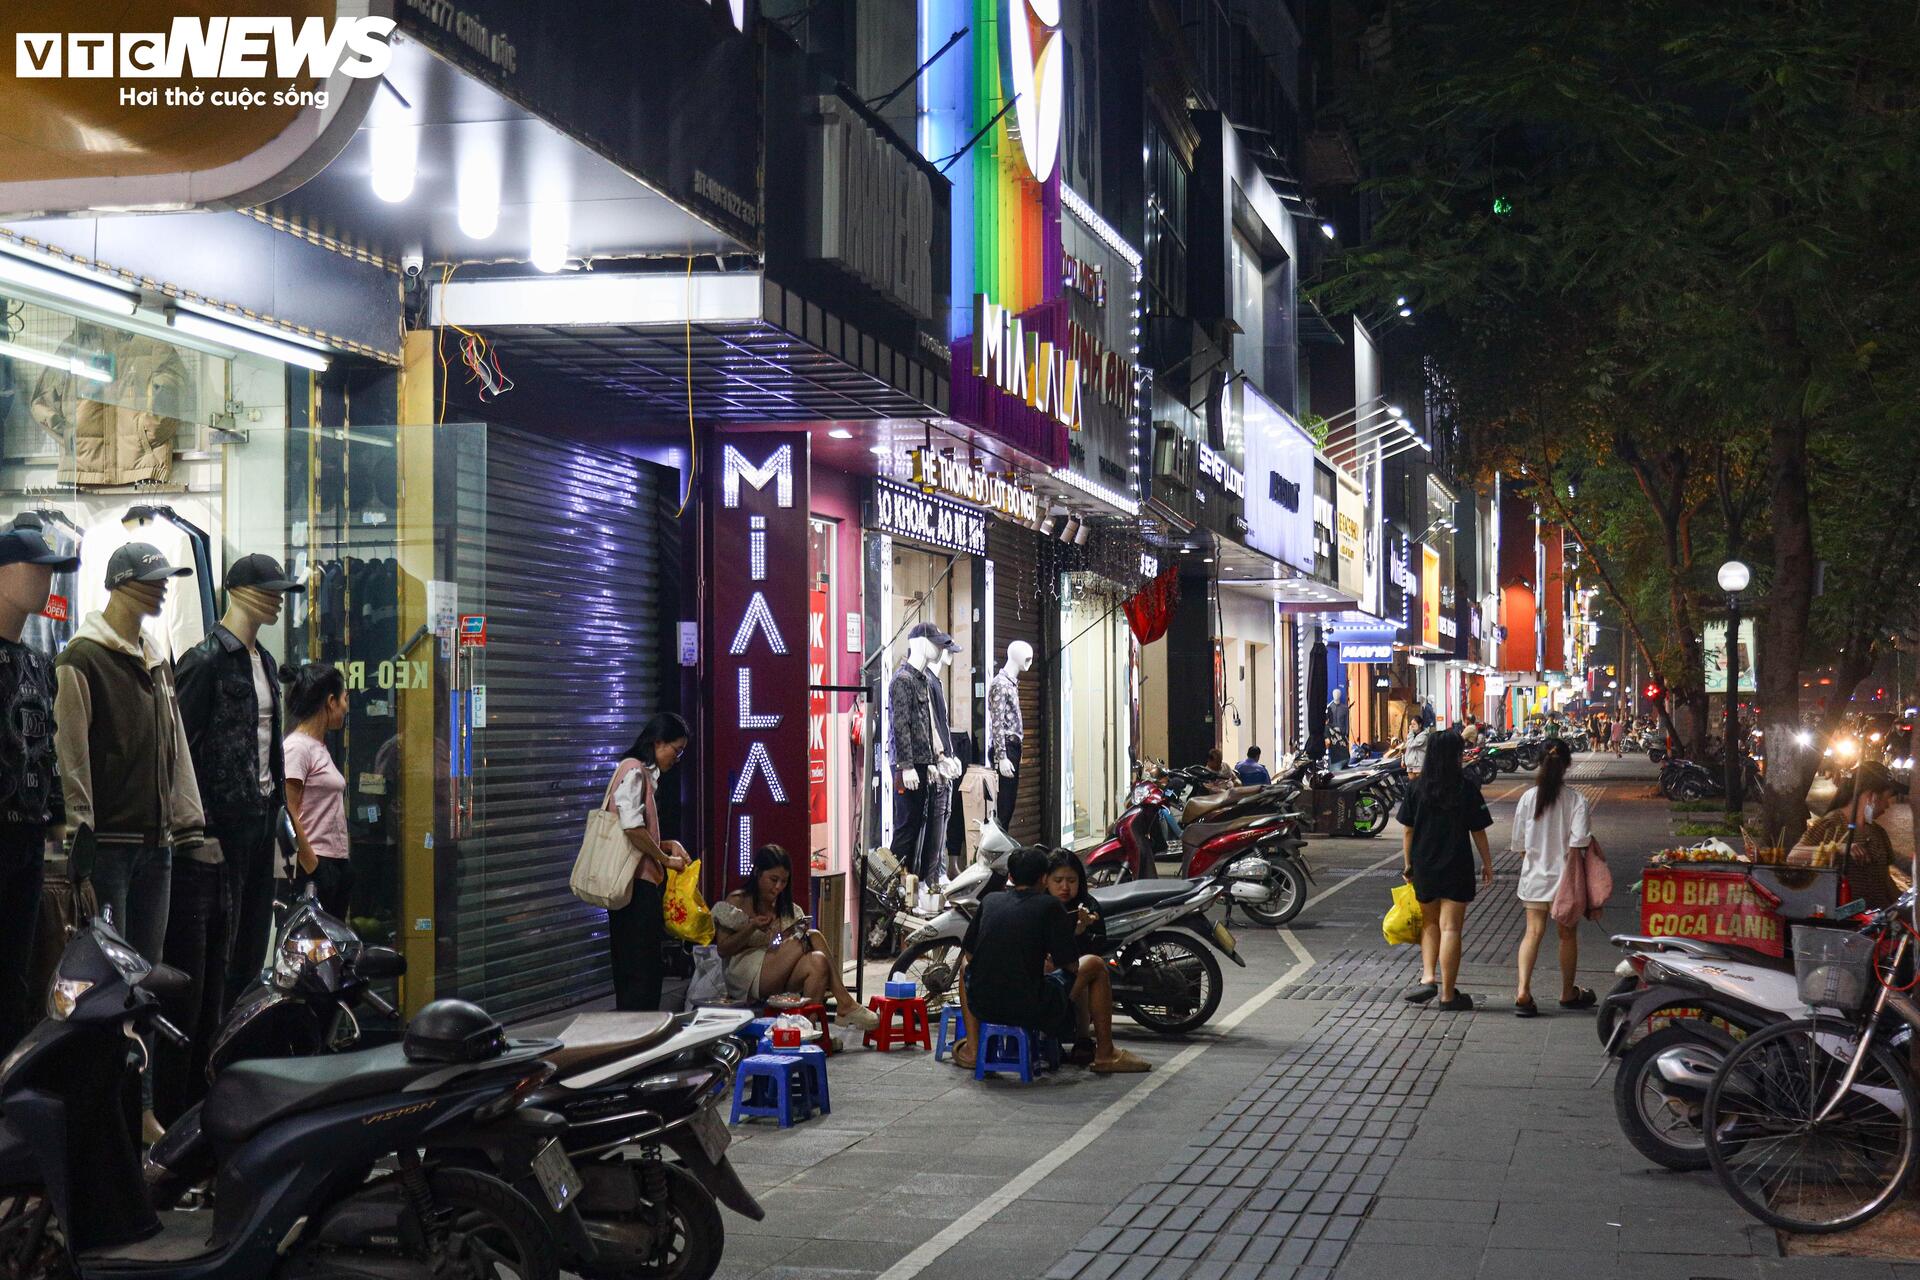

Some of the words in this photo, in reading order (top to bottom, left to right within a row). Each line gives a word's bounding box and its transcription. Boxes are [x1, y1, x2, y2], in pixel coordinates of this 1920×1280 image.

[46, 606, 66, 618] OPEN
[1683, 878, 1719, 906] BÍA
[1649, 912, 1708, 936] COCA
[1715, 913, 1777, 941] LẠNH
